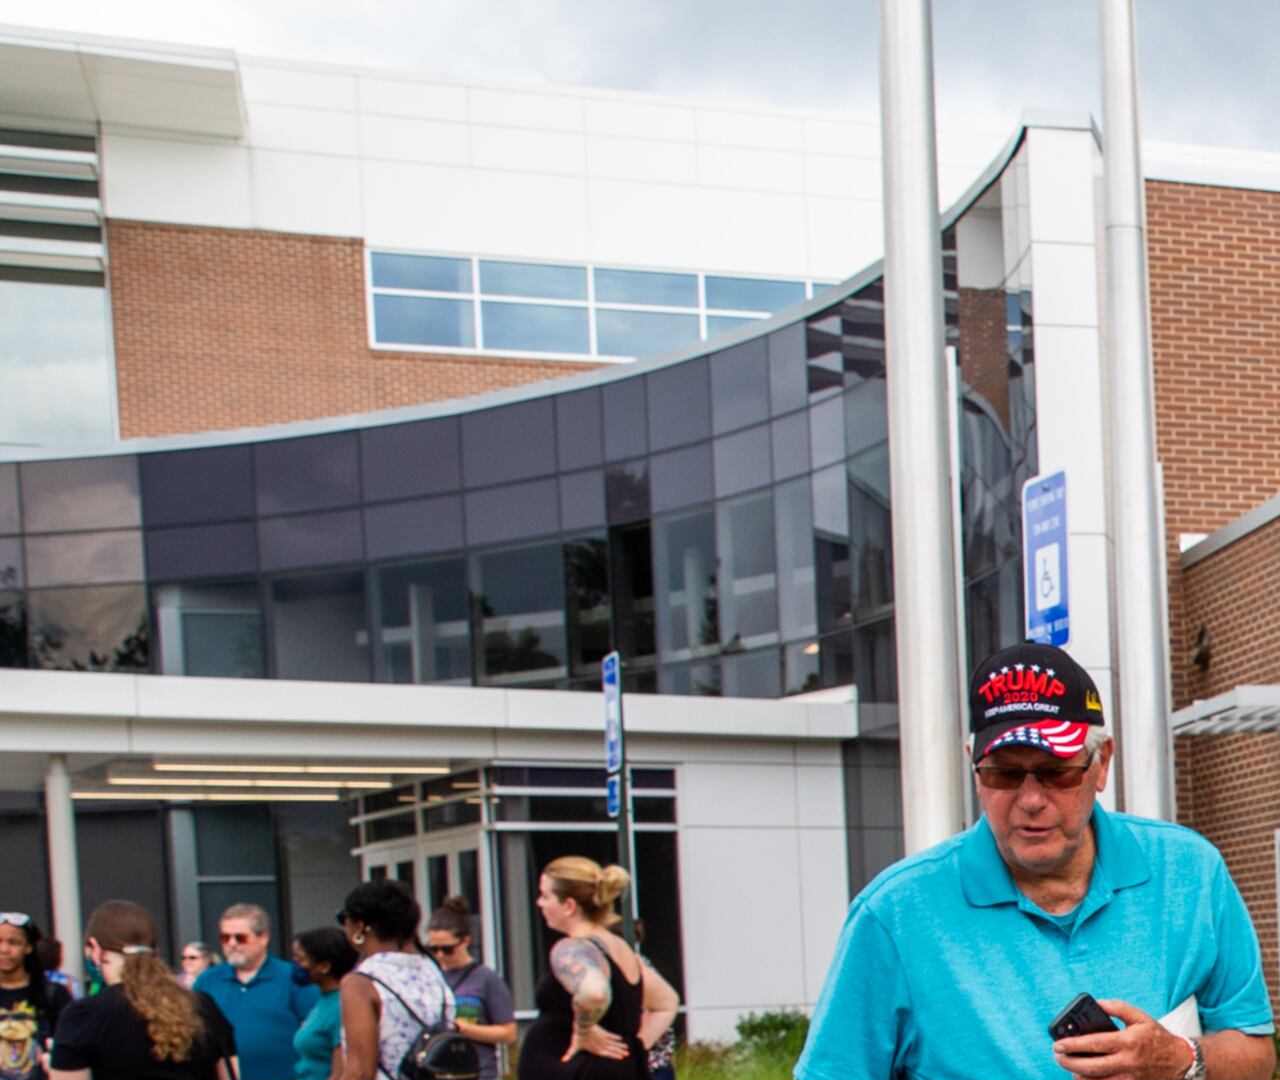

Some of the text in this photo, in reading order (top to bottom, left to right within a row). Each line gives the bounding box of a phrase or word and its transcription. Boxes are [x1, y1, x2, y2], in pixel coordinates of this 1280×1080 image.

[978, 669, 1067, 704] TRUMP
[1003, 691, 1039, 704] 2020
[998, 702, 1034, 714] AMERICA
[1034, 702, 1060, 715] GREAT
